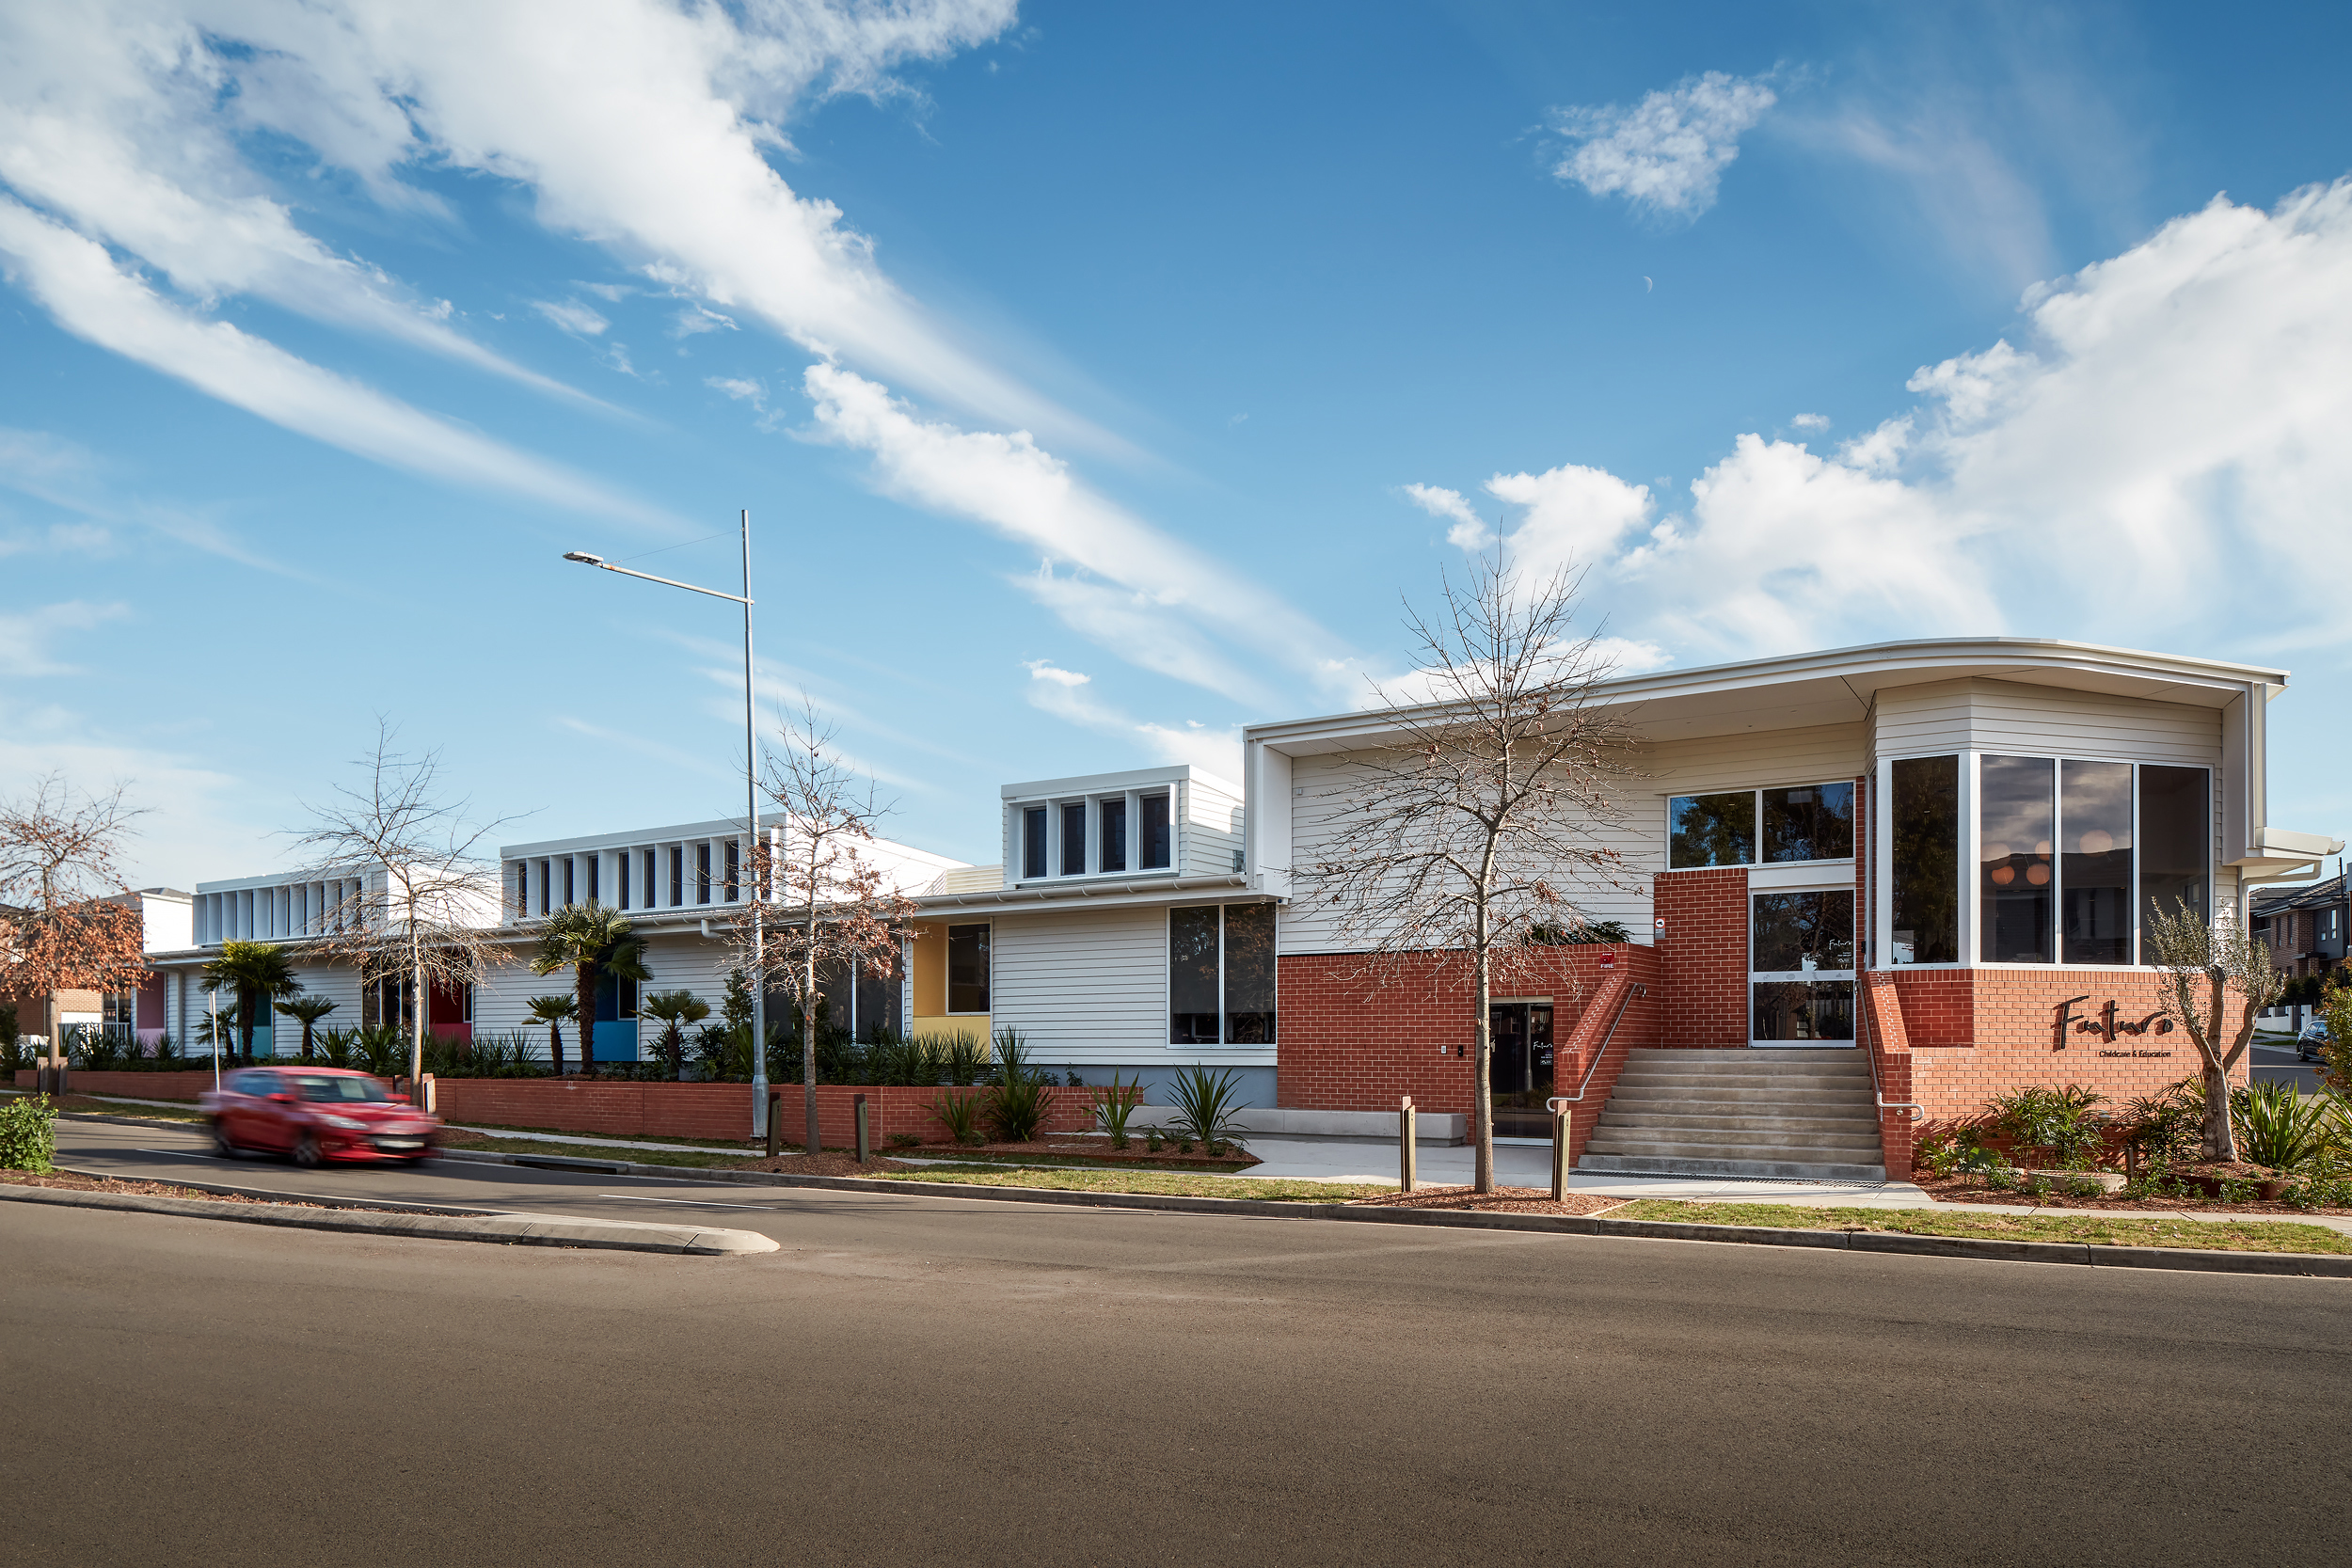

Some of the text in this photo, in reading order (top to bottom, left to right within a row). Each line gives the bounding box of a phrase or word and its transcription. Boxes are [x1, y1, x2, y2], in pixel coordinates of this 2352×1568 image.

[2057, 995, 2174, 1049] Futuro
[2099, 1050, 2171, 1058] Childcare & Education
